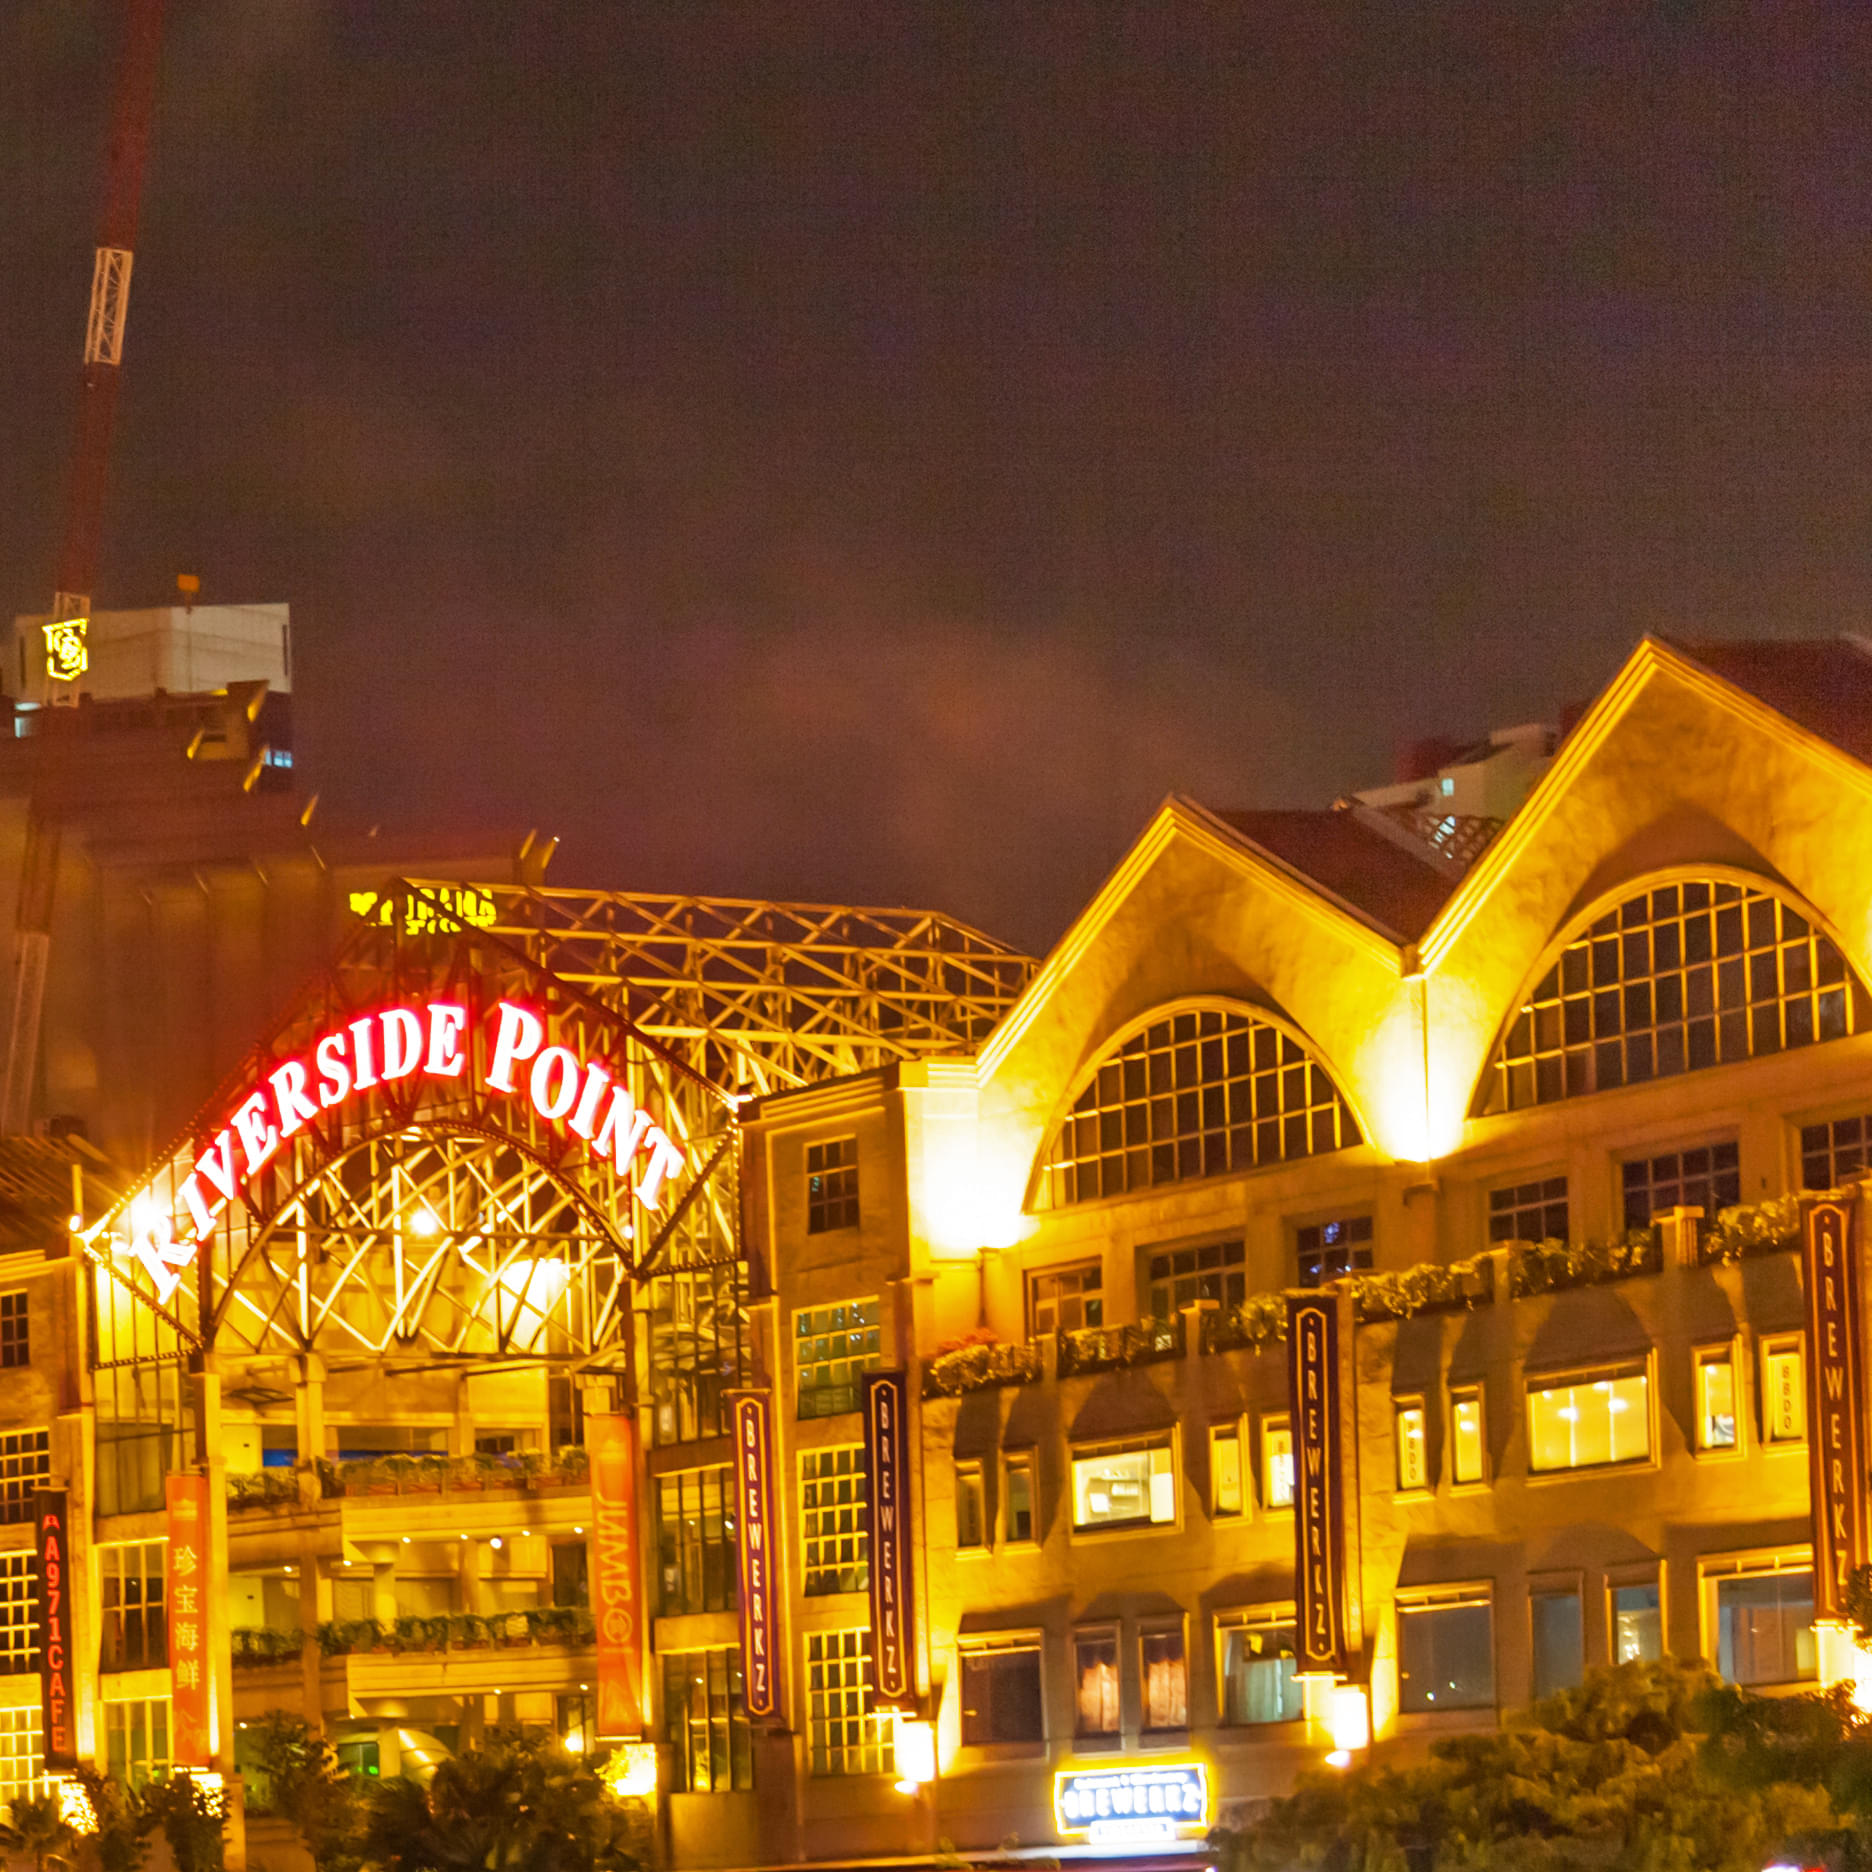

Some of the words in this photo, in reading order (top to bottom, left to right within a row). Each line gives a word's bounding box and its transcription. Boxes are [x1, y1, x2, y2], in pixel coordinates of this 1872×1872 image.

[129, 1003, 466, 1304] RIVERSIDE
[486, 1001, 686, 1211] POINT
[880, 1402, 897, 1674] BREWERKZ
[1307, 1331, 1327, 1635] BREWERKZ
[1822, 1231, 1850, 1586] BREWERKZ
[44, 1536, 66, 1752] A971CAFE
[746, 1419, 766, 1692] BREWERKZ
